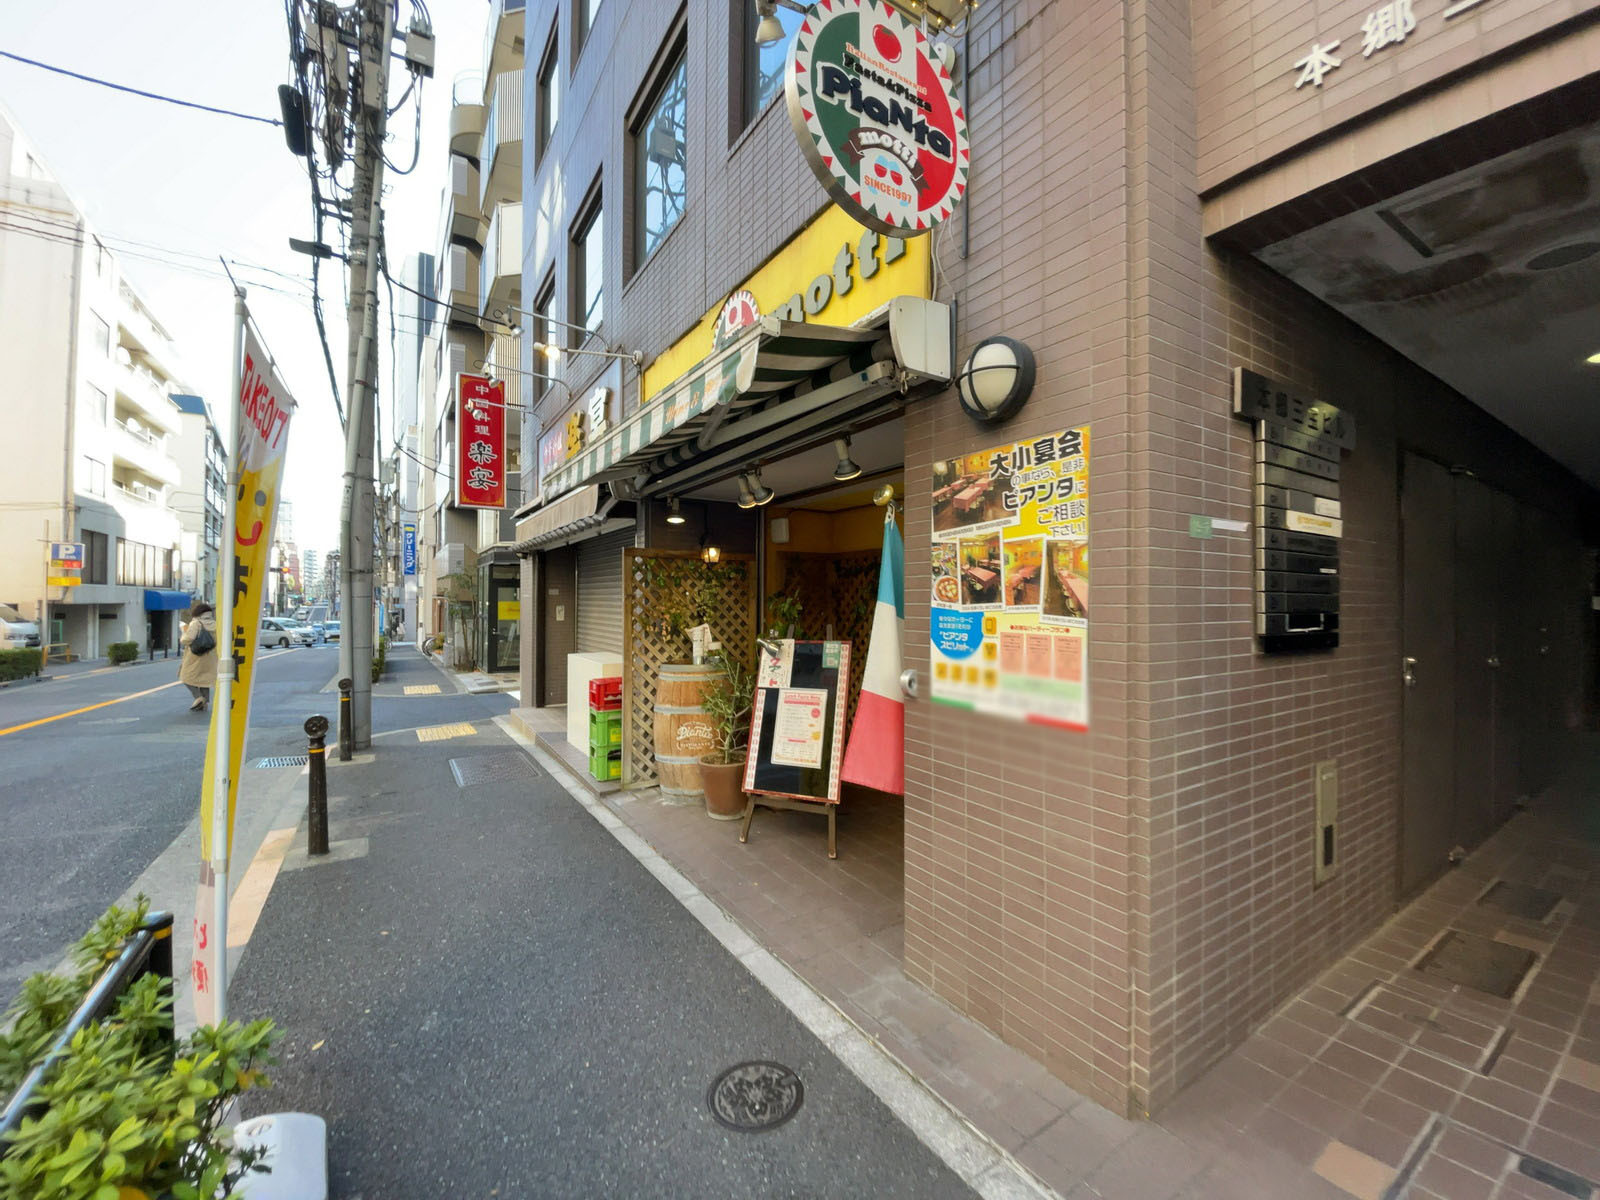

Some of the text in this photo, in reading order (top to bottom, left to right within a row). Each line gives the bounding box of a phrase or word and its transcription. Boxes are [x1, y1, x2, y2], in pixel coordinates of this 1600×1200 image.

[1294, 0, 1481, 88] 本郷
[990, 430, 1082, 479] 大小宴会
[1038, 500, 1086, 525] ご相談
